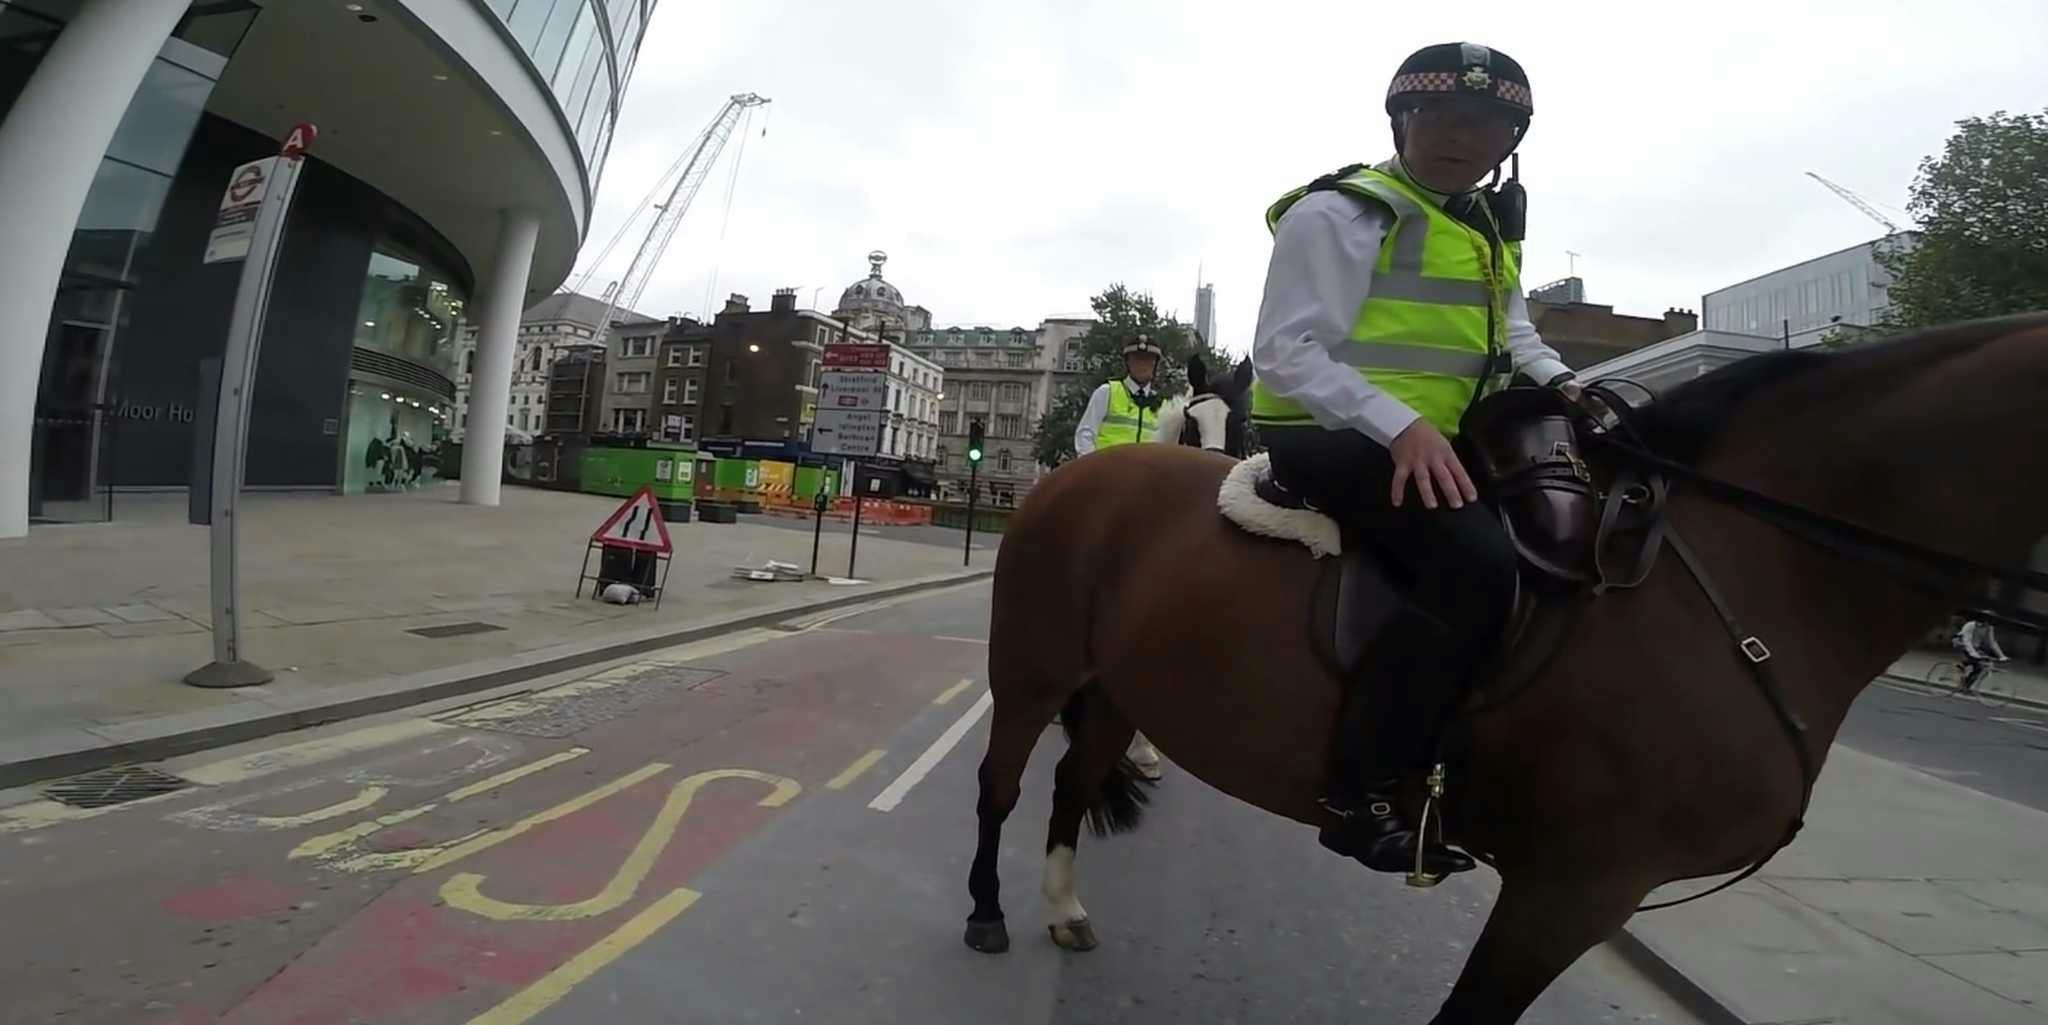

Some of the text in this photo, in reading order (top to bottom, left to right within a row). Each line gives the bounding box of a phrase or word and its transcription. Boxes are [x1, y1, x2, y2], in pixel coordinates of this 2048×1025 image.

[283, 127, 304, 152] A
[847, 412, 871, 422] Angel
[838, 432, 876, 442] Barbican
[841, 442, 869, 452] Centre
